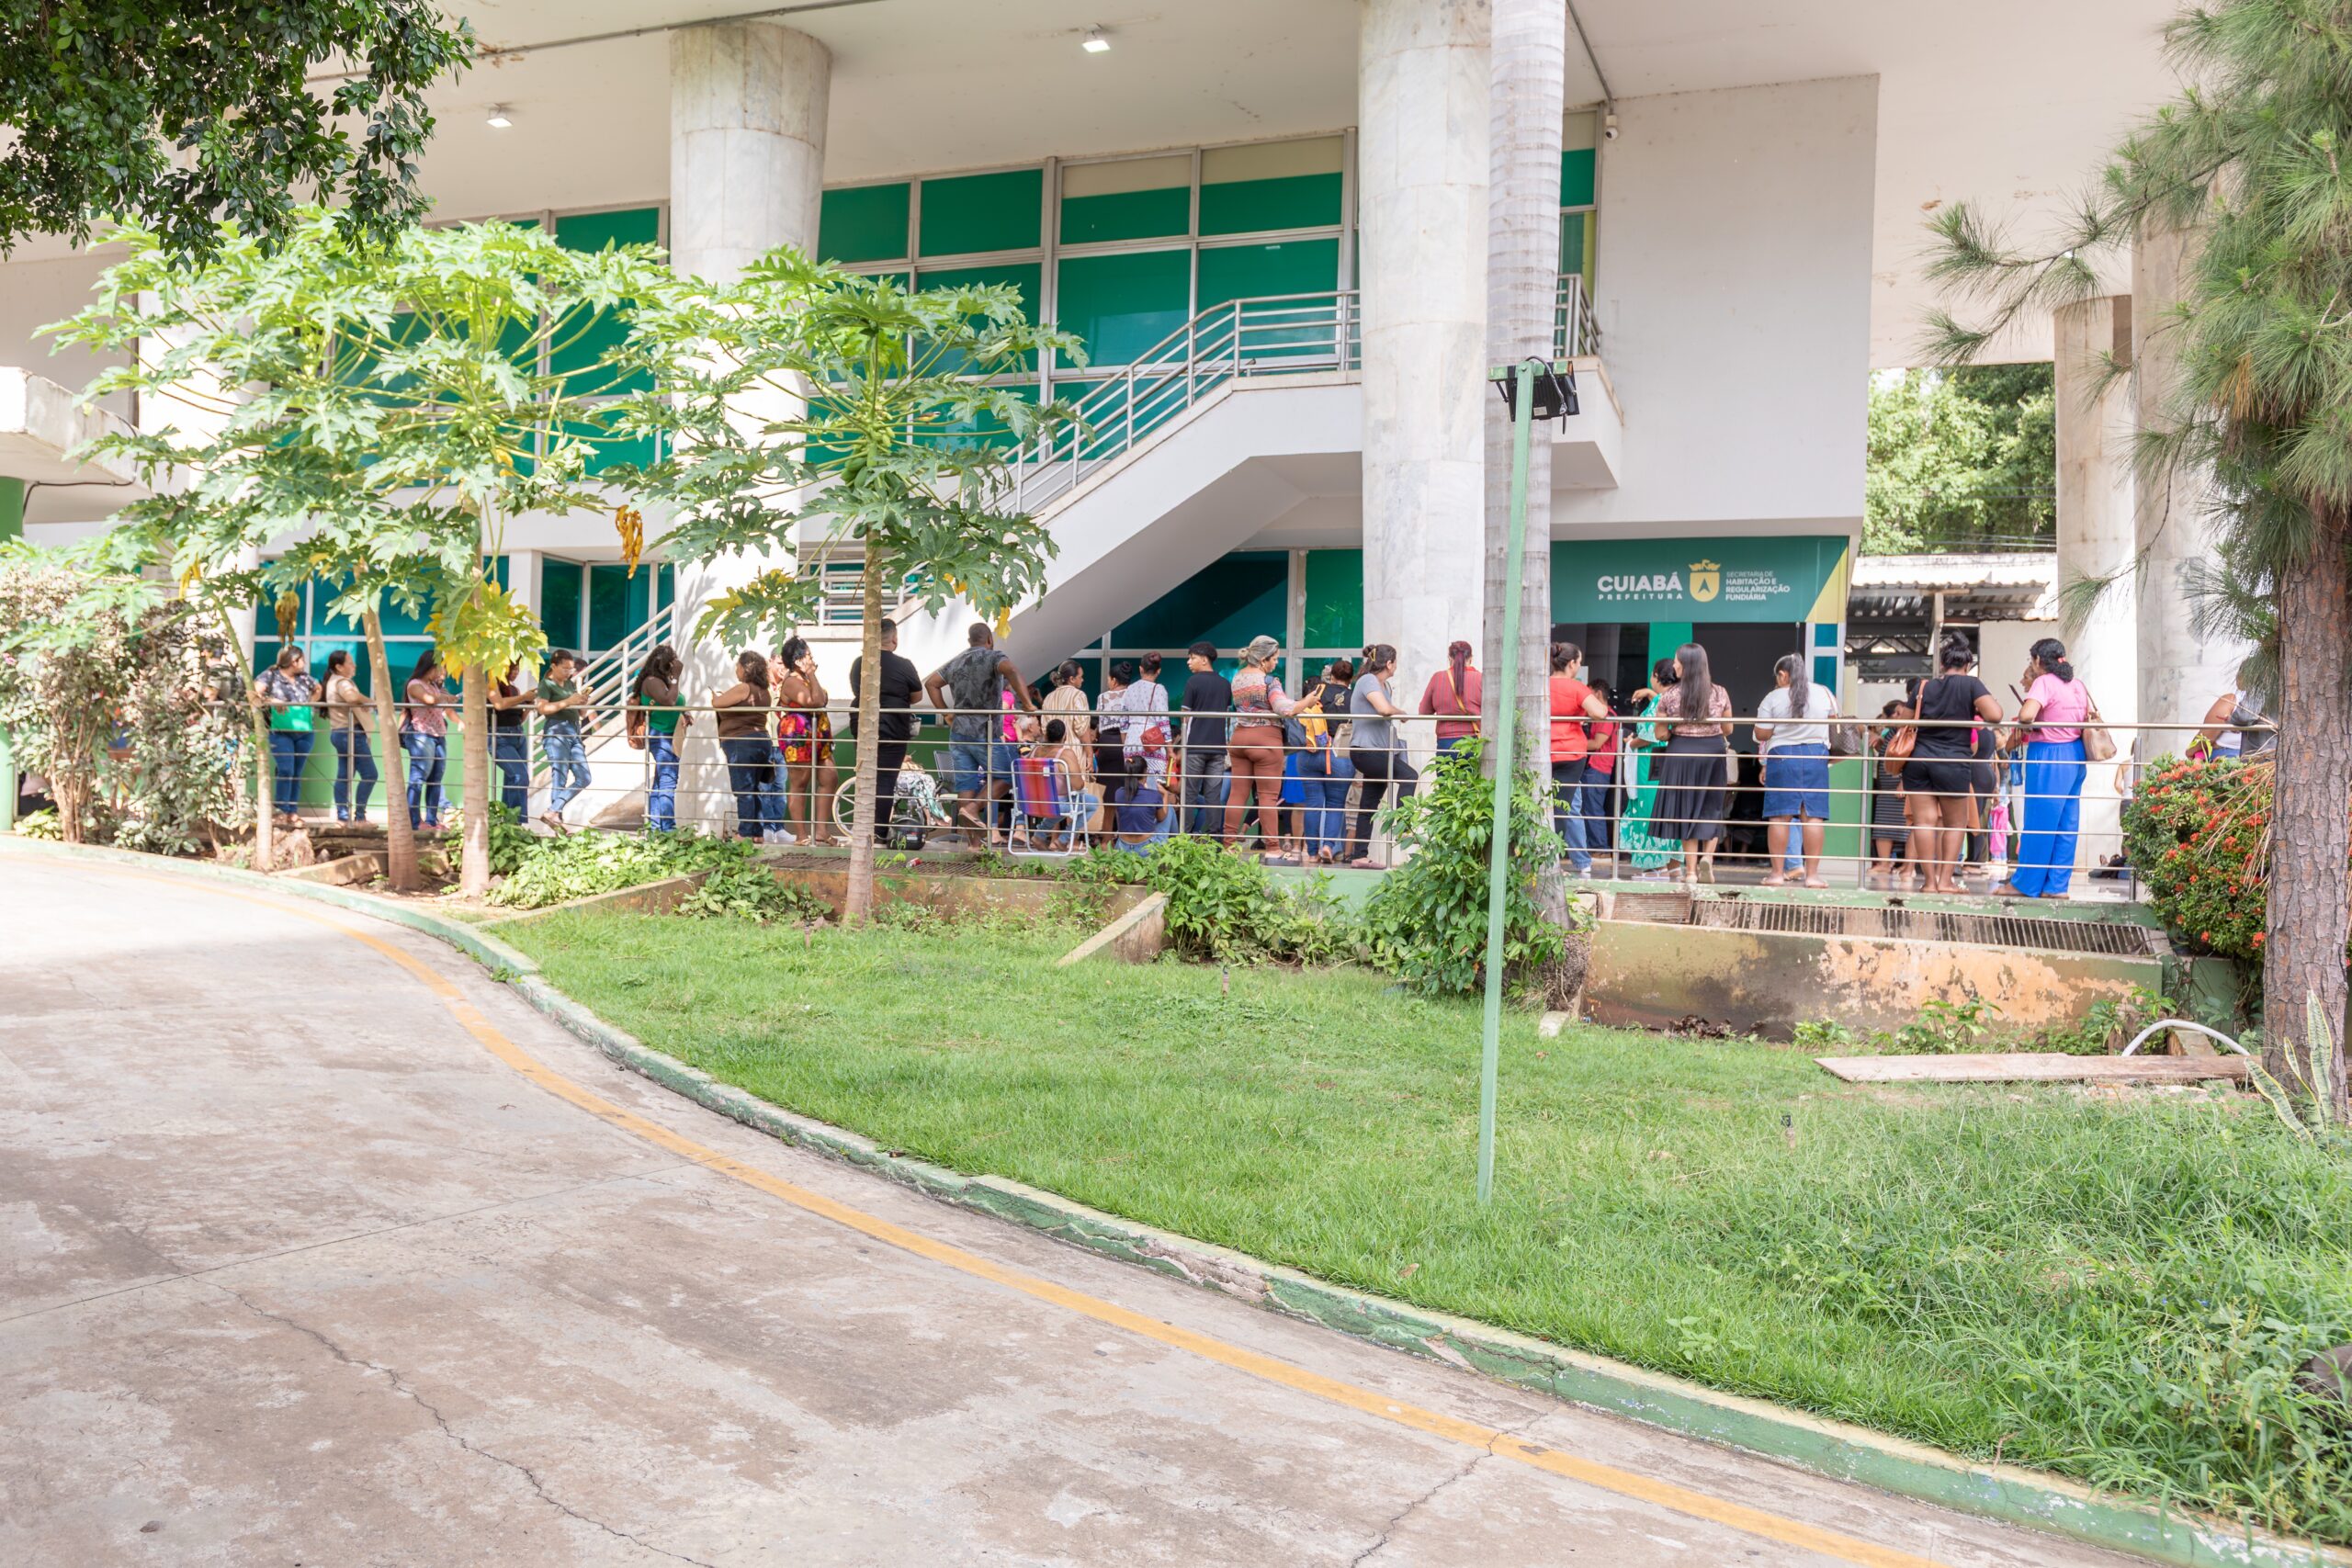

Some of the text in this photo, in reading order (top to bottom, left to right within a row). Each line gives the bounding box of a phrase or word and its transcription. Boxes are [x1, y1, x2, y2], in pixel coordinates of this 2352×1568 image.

[1597, 571, 1683, 592] CUIABÁ
[1726, 577, 1770, 586] HABITAÇÃO
[1725, 584, 1791, 593] REGULARIZAÇÃO
[1725, 592, 1767, 601] FUNDIÁRIA
